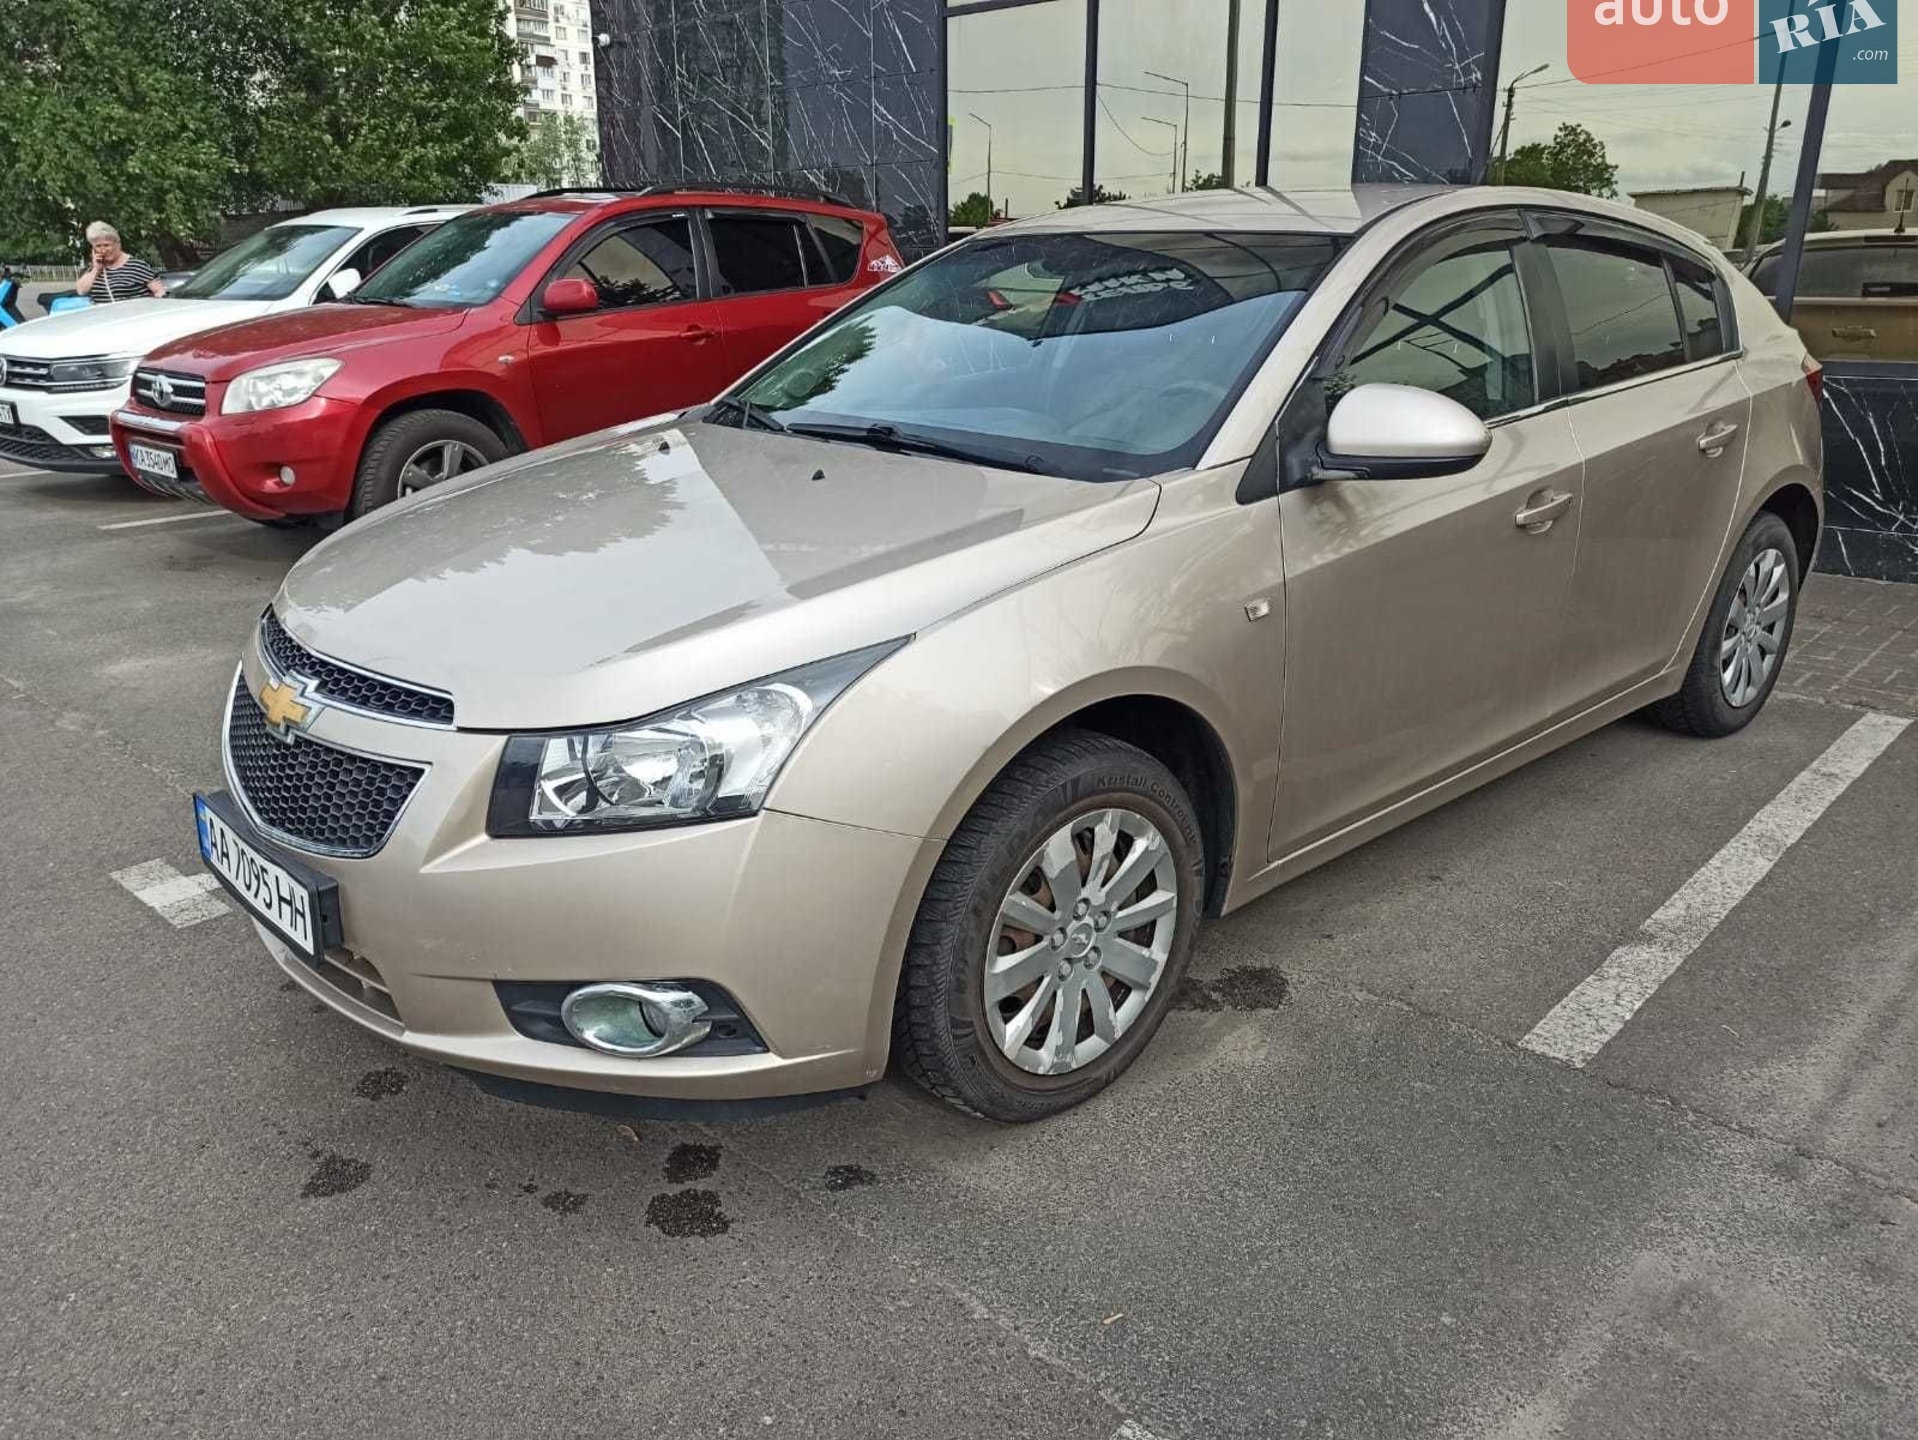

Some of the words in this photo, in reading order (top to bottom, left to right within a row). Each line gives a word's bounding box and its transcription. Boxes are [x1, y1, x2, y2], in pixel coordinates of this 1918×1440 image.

[209, 816, 231, 873] AA
[233, 839, 273, 911] 7095
[275, 875, 308, 941] HH
